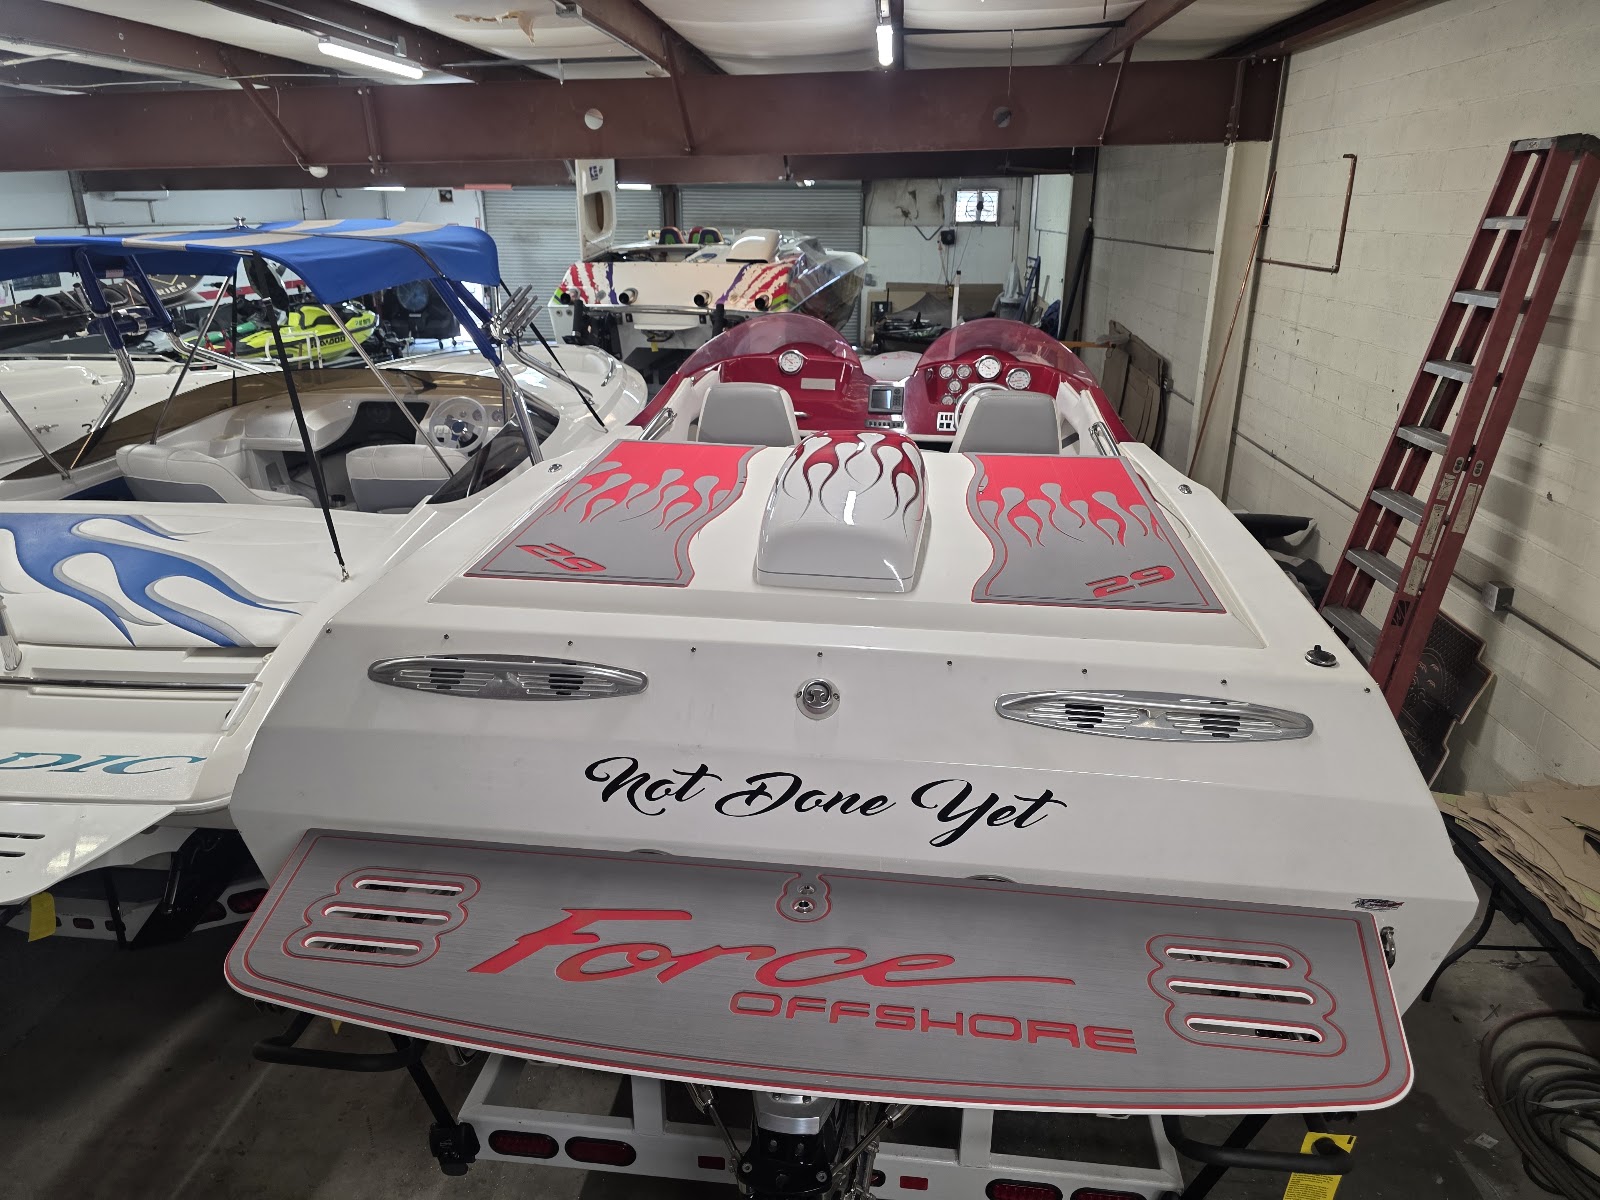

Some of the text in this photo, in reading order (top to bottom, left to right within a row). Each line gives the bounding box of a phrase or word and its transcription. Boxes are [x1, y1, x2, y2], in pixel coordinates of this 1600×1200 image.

[515, 542, 607, 573] 29
[1084, 565, 1176, 598] 29
[584, 756, 1068, 848] Not Done Yet
[467, 908, 1076, 989] Force
[729, 991, 1138, 1056] OFFSHORE
